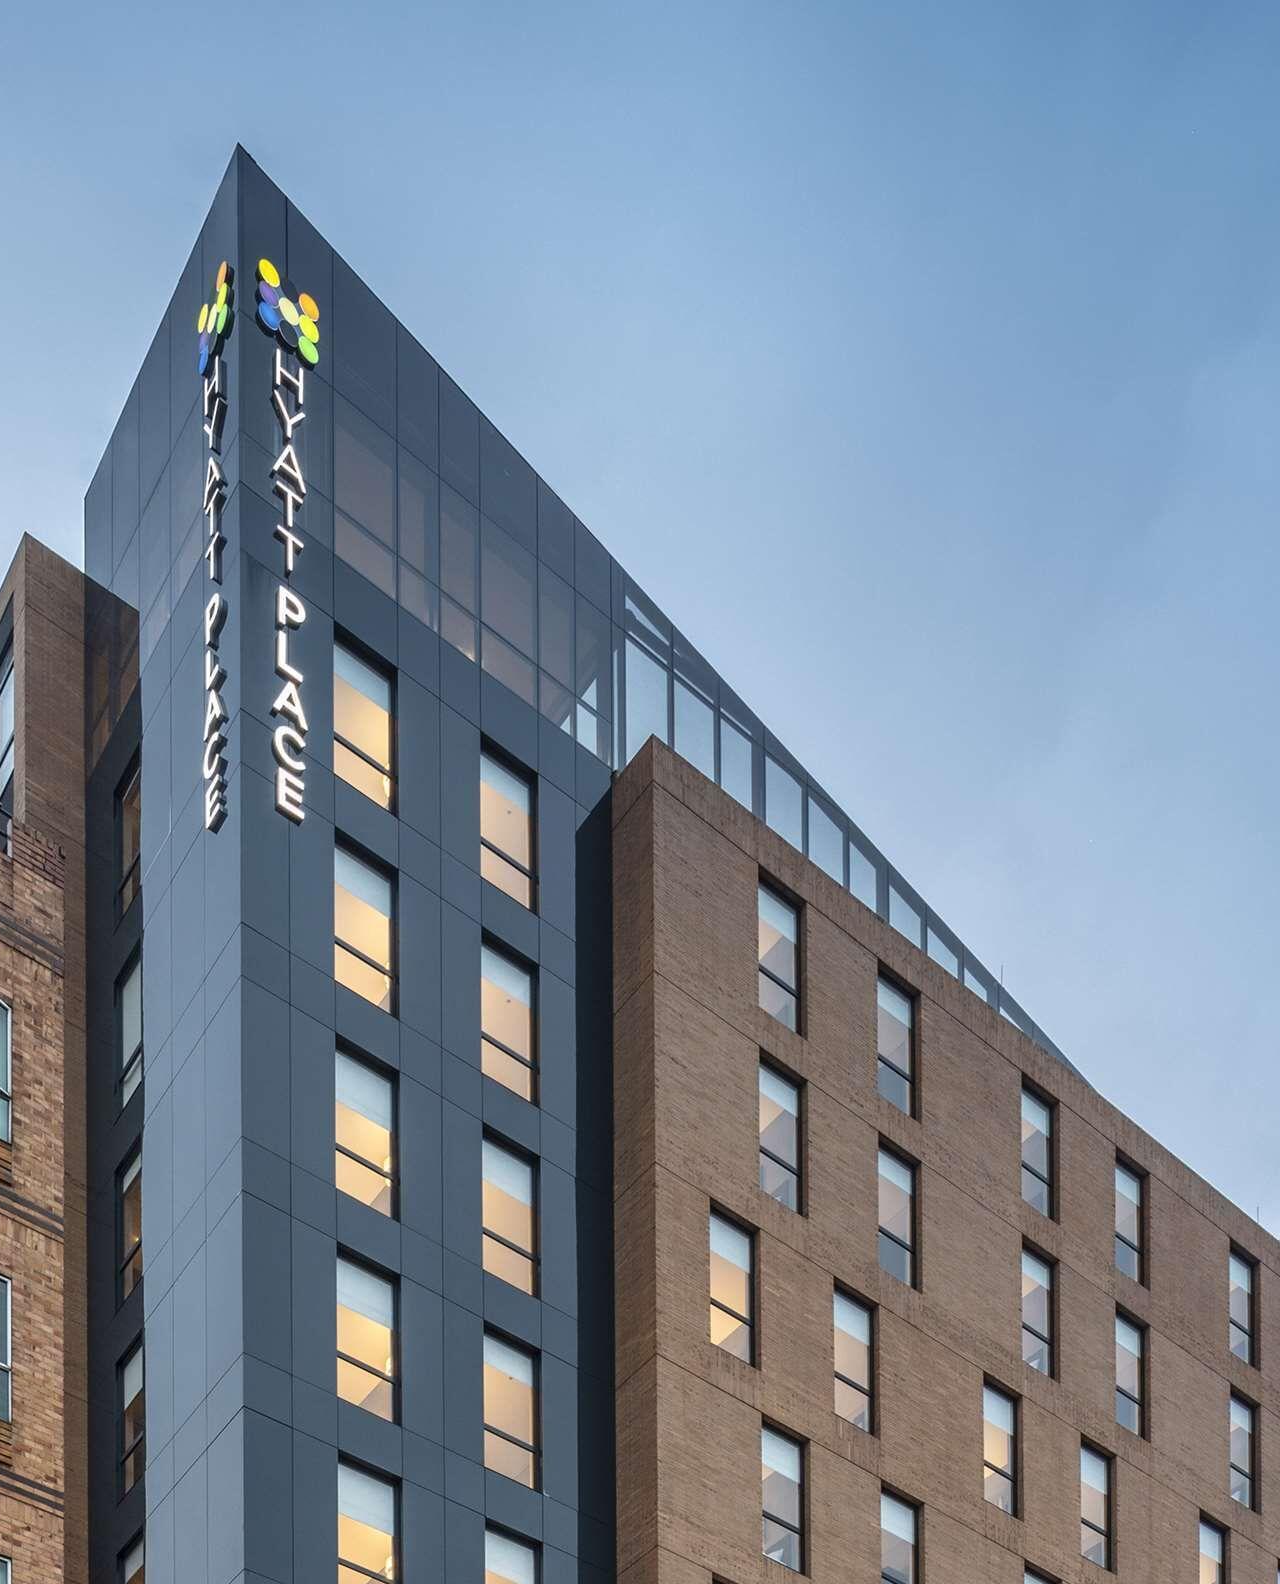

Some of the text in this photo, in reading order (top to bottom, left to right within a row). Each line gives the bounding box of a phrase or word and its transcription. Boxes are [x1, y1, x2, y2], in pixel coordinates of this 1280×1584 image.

[203, 355, 227, 831] HYATT PLACE
[272, 349, 308, 822] HYATT PLACE
